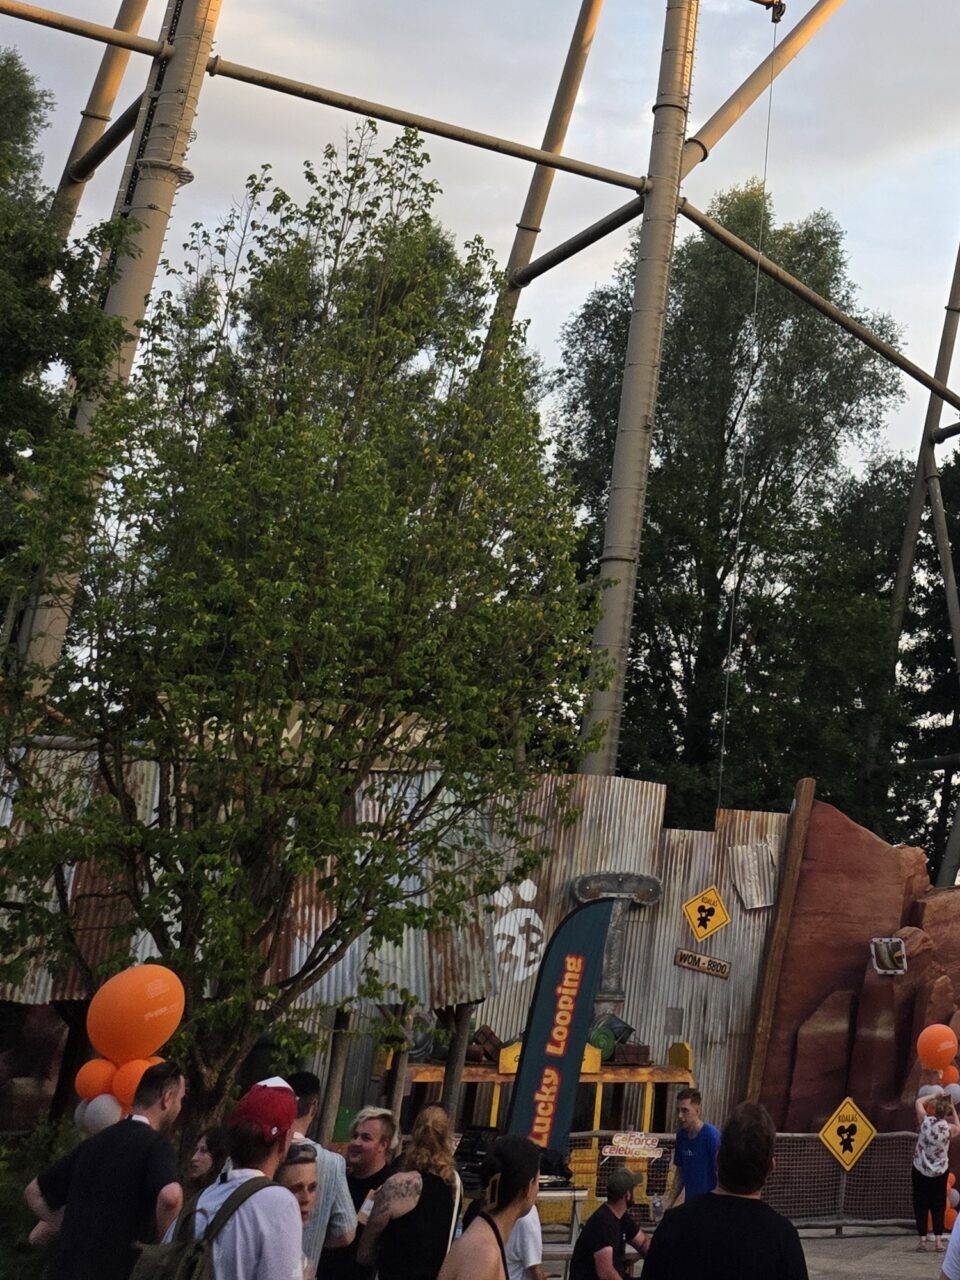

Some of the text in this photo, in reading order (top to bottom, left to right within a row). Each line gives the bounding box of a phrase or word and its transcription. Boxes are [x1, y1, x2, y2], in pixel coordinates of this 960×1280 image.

[679, 951, 702, 968] WOM
[707, 959, 727, 974] 8800
[528, 955, 583, 1149] Lucky Looping
